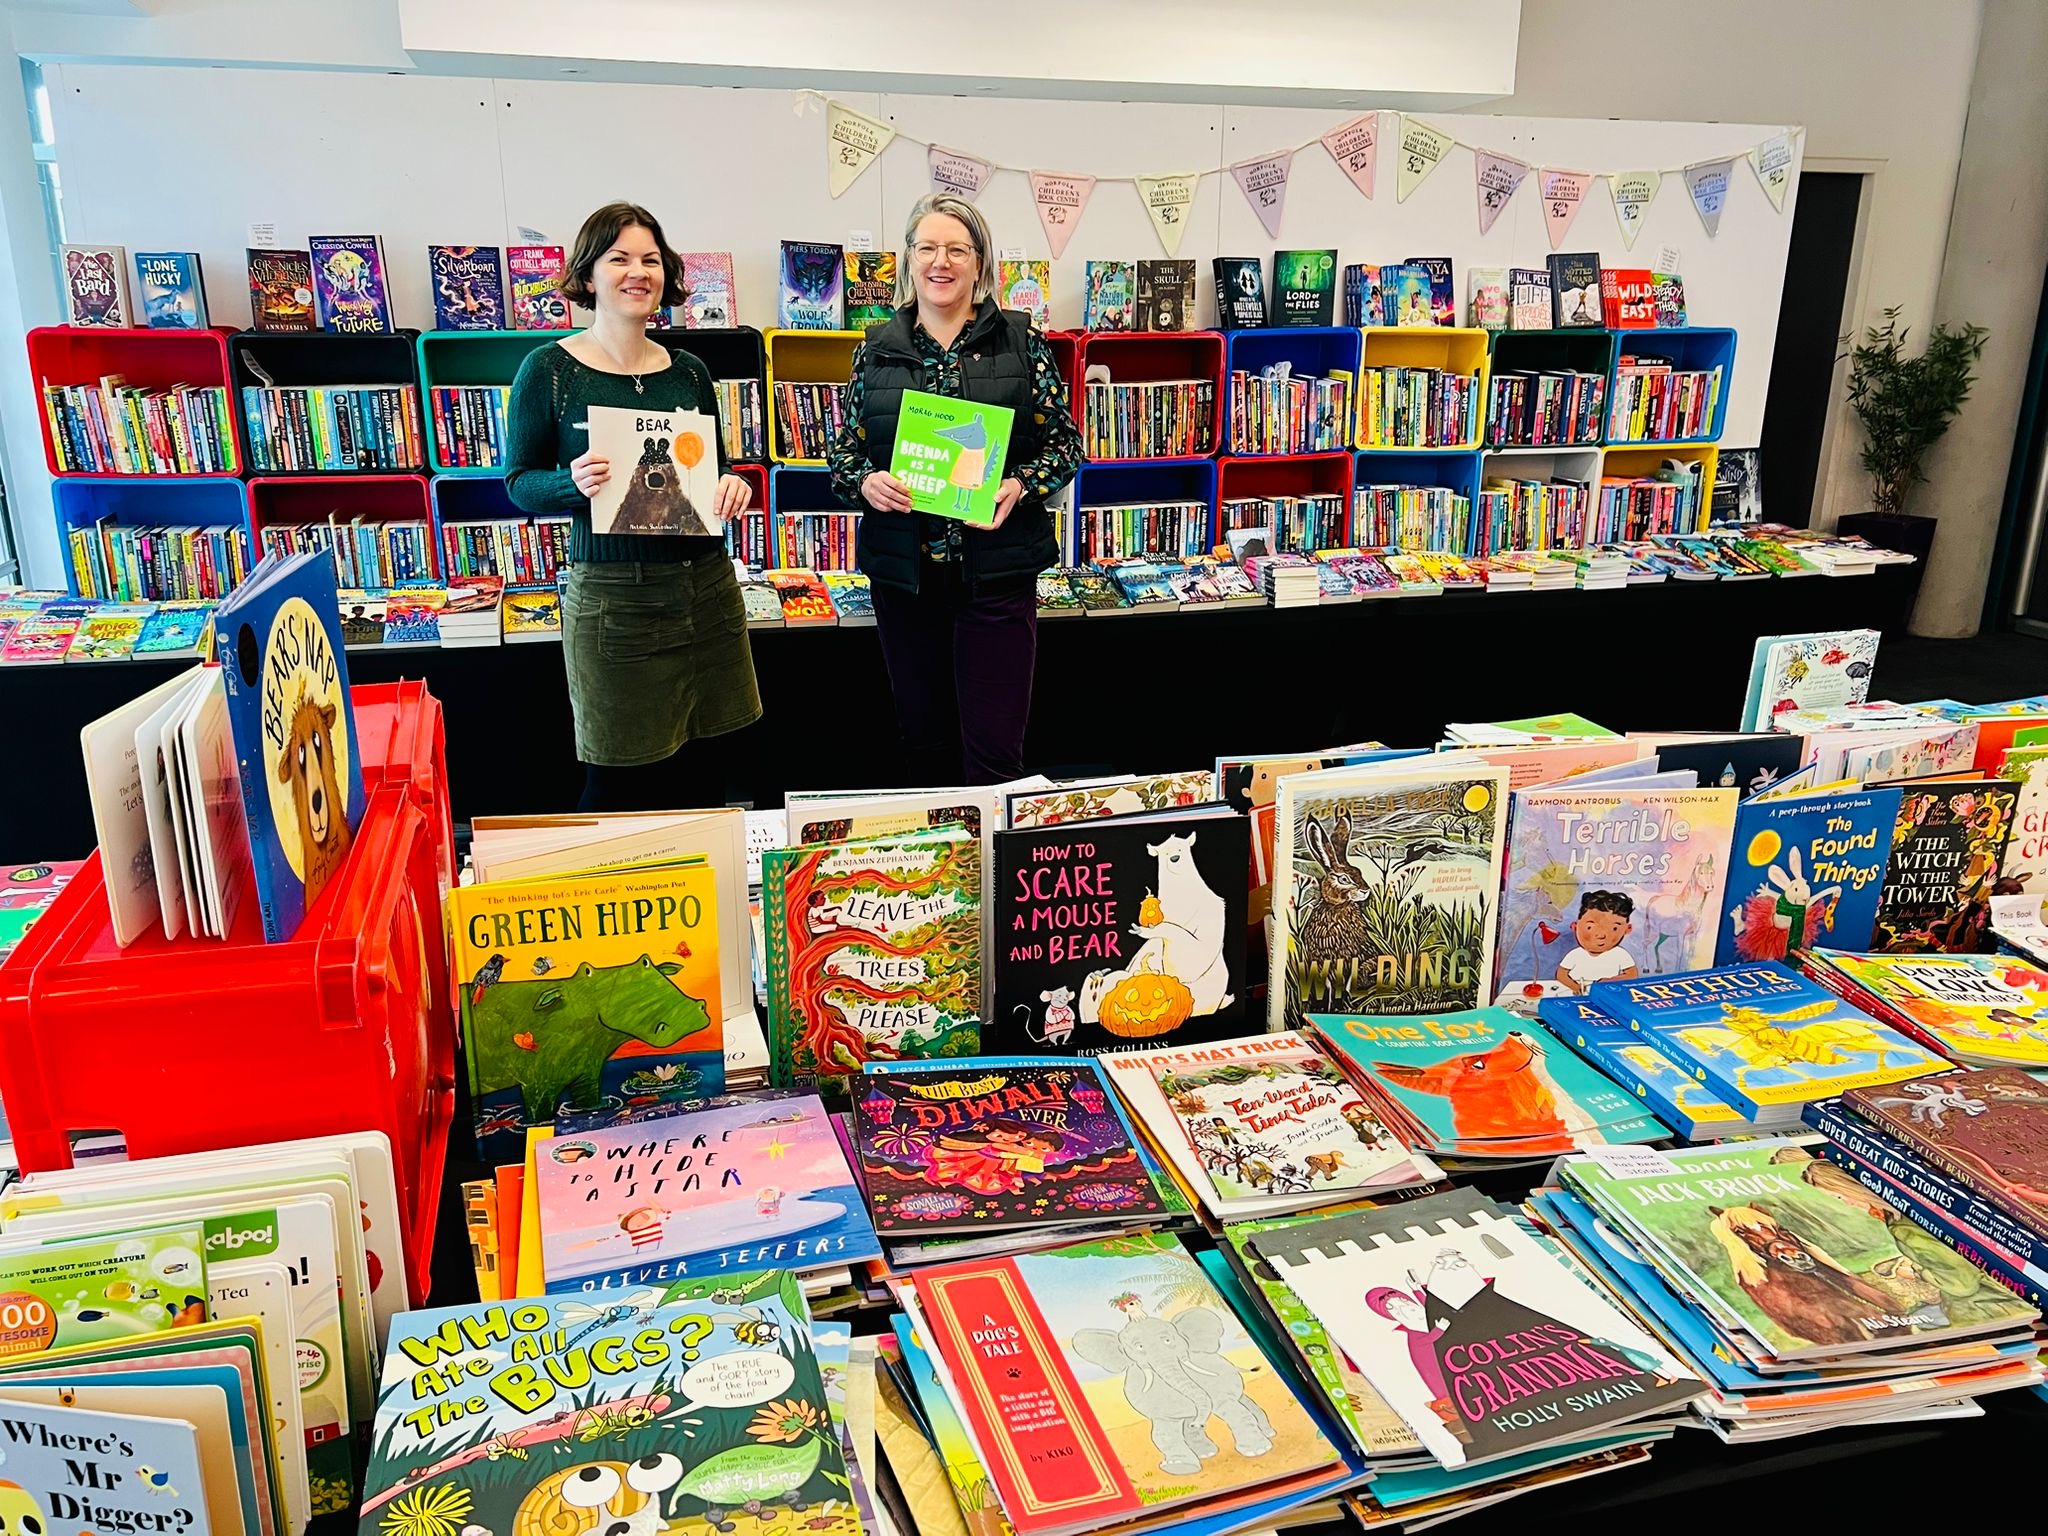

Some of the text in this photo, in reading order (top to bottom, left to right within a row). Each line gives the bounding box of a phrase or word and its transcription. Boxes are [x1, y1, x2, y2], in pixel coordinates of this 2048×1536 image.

[833, 130, 878, 151] BOOK CENTRE
[834, 123, 878, 145] CHILDREN'S
[936, 164, 979, 182] CHILDREN'S
[954, 176, 978, 188] CENTRE
[1038, 187, 1080, 197] CHILDREN'S
[1038, 194, 1079, 204] BOOK CENTRE
[346, 242, 374, 250] COWELL
[524, 250, 544, 260] FRANK
[810, 246, 838, 256] TORDAY
[146, 260, 178, 272] LONE
[510, 258, 561, 270] COTTRELL-BOYCE
[1160, 266, 1174, 274] THE
[145, 272, 182, 286] HUSKY
[1154, 276, 1182, 284] SKULL
[1516, 273, 1532, 284] MAL
[1532, 274, 1550, 286] PEET
[1014, 292, 1038, 300] EARTH
[1286, 290, 1311, 300] LORD
[1618, 284, 1652, 298] WILD
[1295, 300, 1320, 310] FLIES
[1621, 305, 1654, 318] EAST
[798, 310, 827, 321] WOLF
[636, 418, 672, 432] BEAR
[900, 440, 950, 462] BRENDA
[910, 460, 935, 472] IS A
[896, 469, 947, 496] SHEEP
[787, 597, 826, 606] I AM
[783, 605, 832, 618] WOLF
[265, 614, 336, 751] BEAR'S NAP
[1528, 797, 1622, 806] RAYMOND ANTROBUS
[1644, 796, 1661, 804] KEN
[1768, 798, 1872, 818] A peep-through storybook
[1557, 810, 1691, 845] Terrible
[1826, 816, 1853, 834] The
[1032, 842, 1096, 862] HOW TO
[1811, 828, 1878, 860] Found
[1915, 837, 1950, 850] THE
[832, 854, 925, 868] BENJAMIN ZEPHANIAH
[1568, 848, 1673, 876] Horses
[1896, 852, 1960, 870] WITCH
[1015, 862, 1114, 902] SCARE
[1812, 862, 1880, 891] Things
[1900, 872, 1950, 884] IN THE
[574, 887, 592, 898] Eric
[625, 882, 669, 892] Washington
[1883, 885, 1957, 906] TOWER
[846, 896, 948, 922] LEAVE THE
[1012, 901, 1118, 932] A MOUSE
[2000, 910, 2032, 920] This Book
[468, 895, 702, 949] GREEN HIPPO
[1010, 931, 1122, 964] AND BEAR
[856, 960, 920, 980] TREES
[1299, 948, 1472, 1002] WILDING
[1628, 970, 1794, 1004] ARTHUR
[1640, 982, 1804, 1010] THE ALWAYS KING
[1378, 1000, 1452, 1014] Angela Harding
[858, 1006, 931, 1028] PLEASE
[1344, 1018, 1496, 1041] One Fox
[1077, 1040, 1169, 1058] ROSS COLLINS
[1112, 1037, 1306, 1072] MILO'S HAT TRICK
[921, 1078, 1000, 1097] THE BEST
[912, 1082, 1067, 1128] DIWALI
[1224, 1081, 1314, 1117] Ten-Word
[1018, 1109, 1074, 1131] EVER
[1239, 1092, 1337, 1134] Tiny Tales
[606, 1130, 733, 1161] WHERE
[570, 1152, 718, 1185] TO HIDE
[1818, 1118, 1955, 1209] SUPER GREAT KIDS' STORIES
[586, 1168, 742, 1202] A STAR
[1628, 1172, 1800, 1208] JACK BROCK
[32, 1254, 146, 1275] WORK OUT WHICH CREATURE
[582, 1236, 846, 1293] OLIVER JEFFERS
[218, 1286, 250, 1301] Tea
[982, 1314, 996, 1327] A
[399, 1306, 551, 1367] WHO
[971, 1325, 1020, 1344] DOG'S
[982, 1341, 1023, 1358] TALE
[1444, 1322, 1580, 1375] COLIN'S
[411, 1328, 568, 1402] Ate All
[712, 1358, 762, 1372] The TRUE
[403, 1313, 716, 1440] The BUGS?
[696, 1366, 782, 1384] and GORY story
[747, 1378, 768, 1388] food
[1452, 1342, 1646, 1422] GRANDMA
[724, 1390, 757, 1400] chain!
[1491, 1380, 1646, 1434] HOLLY SWAIN
[1010, 1418, 1068, 1432] imagination
[1, 1418, 134, 1458] Where's
[1030, 1446, 1074, 1464] by KIKO
[64, 1458, 123, 1492] Mr
[46, 1490, 194, 1536] Digger?
